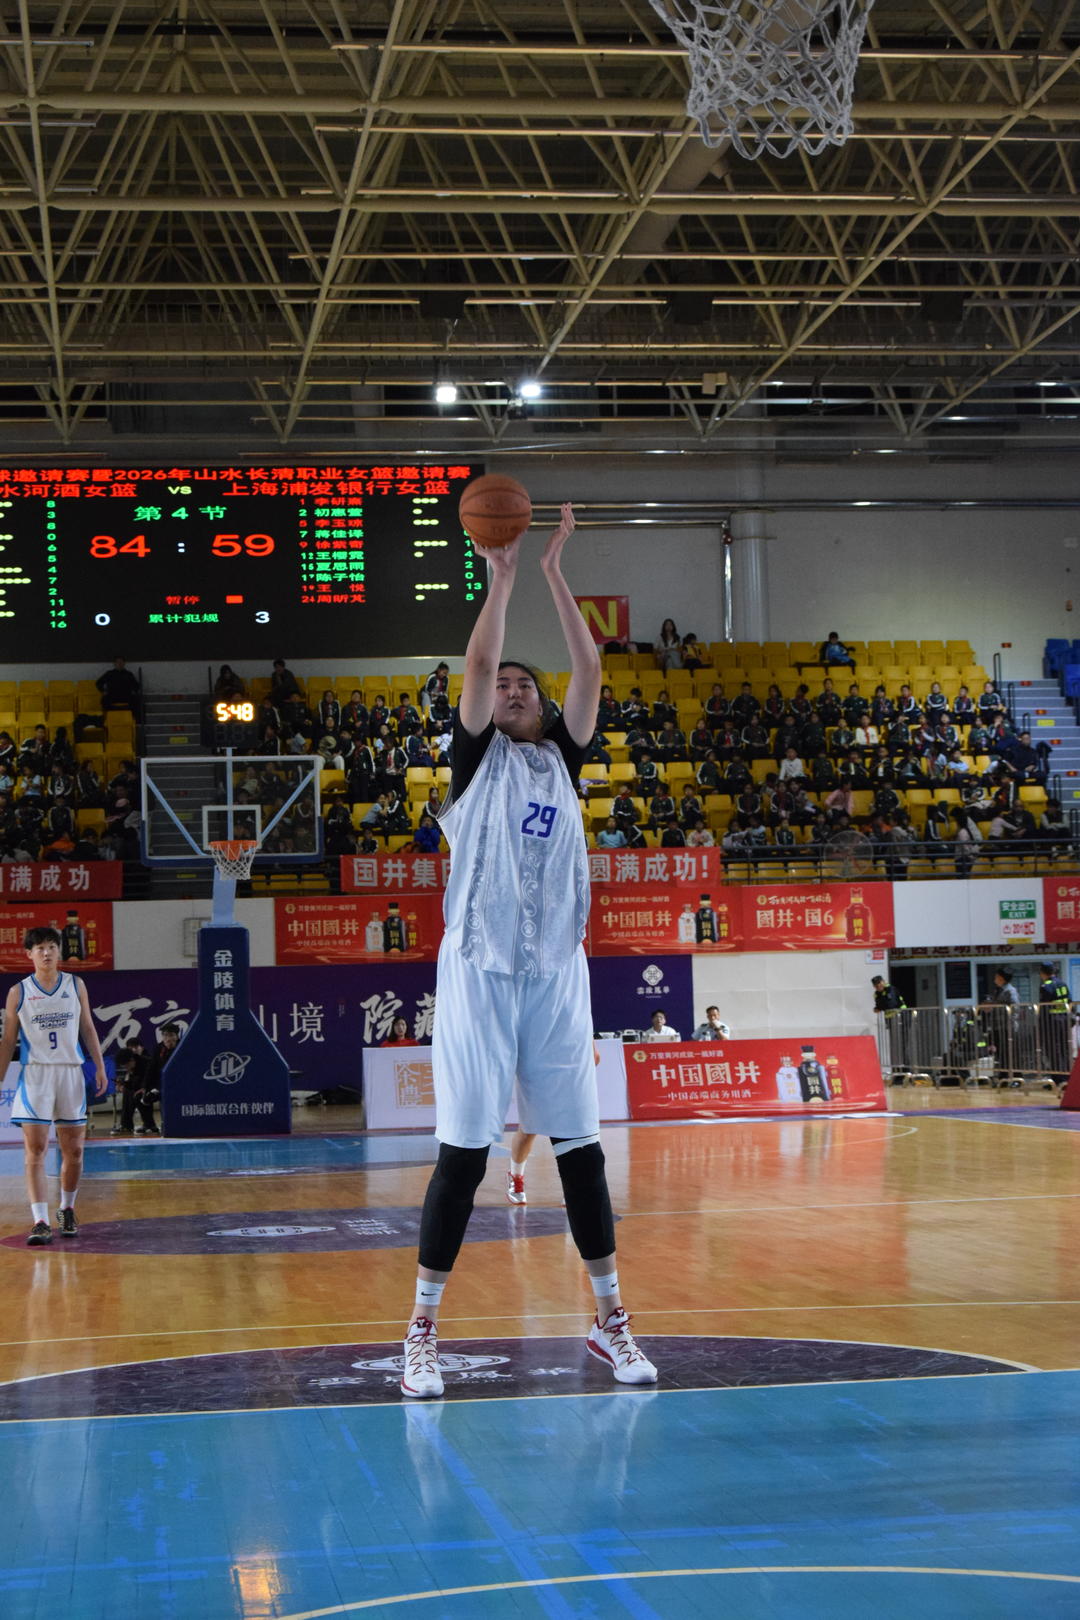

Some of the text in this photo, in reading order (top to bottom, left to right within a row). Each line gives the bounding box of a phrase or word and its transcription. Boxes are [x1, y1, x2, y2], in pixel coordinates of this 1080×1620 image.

[222, 481, 450, 496] 上海浦发银行女篮
[134, 506, 227, 521] 第 4 节
[90, 535, 151, 558] 84
[212, 534, 274, 557] 59
[463, 550, 474, 558] 4
[464, 571, 474, 579] 0
[466, 582, 483, 590] 13
[95, 614, 110, 625] 0
[148, 613, 219, 623] 累计犯规
[256, 611, 270, 623] 3
[216, 702, 254, 721] 5:48
[521, 802, 557, 838] 29
[0, 864, 90, 893] 满成功
[353, 858, 451, 888] 国井集
[213, 950, 235, 1032] 金陵体育
[48, 1031, 58, 1049] 9
[181, 1102, 275, 1117] 国际篮联合作伙伴
